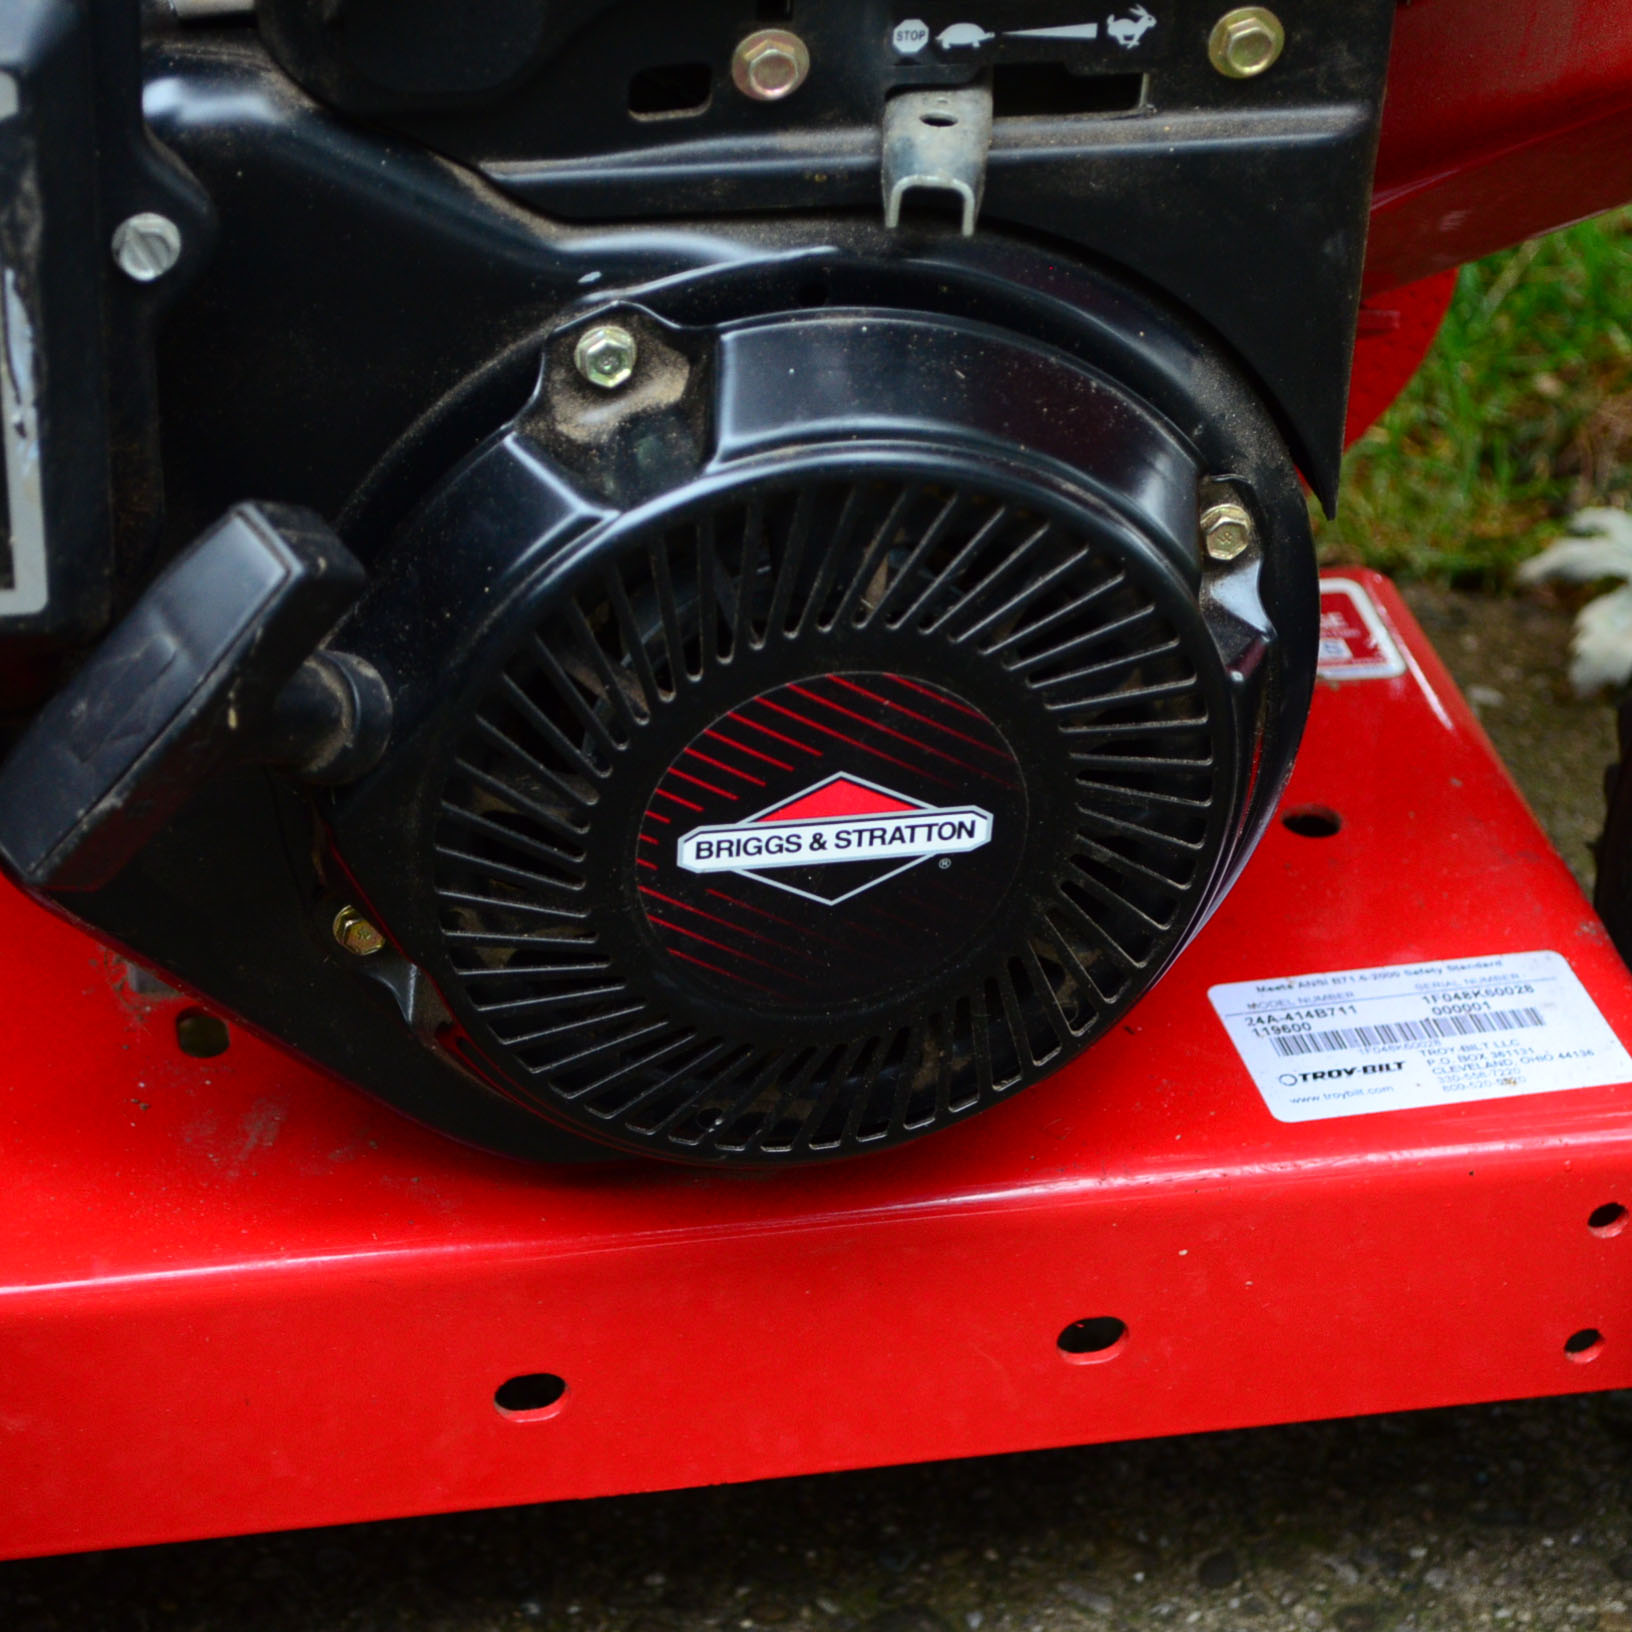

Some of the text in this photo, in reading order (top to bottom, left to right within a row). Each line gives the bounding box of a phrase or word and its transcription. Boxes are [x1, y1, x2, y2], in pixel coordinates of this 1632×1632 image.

[897, 30, 925, 41] STOP
[695, 820, 976, 860] BRIGGS & STRATTON
[1404, 967, 1442, 977] Safety
[1447, 960, 1502, 972] Standard
[1245, 1005, 1358, 1027] 24A-414B711
[1431, 1001, 1492, 1016] 000001
[1252, 1022, 1312, 1037] 119600
[1458, 1052, 1486, 1063] BOX
[1299, 1061, 1406, 1083] TROY-BILT
